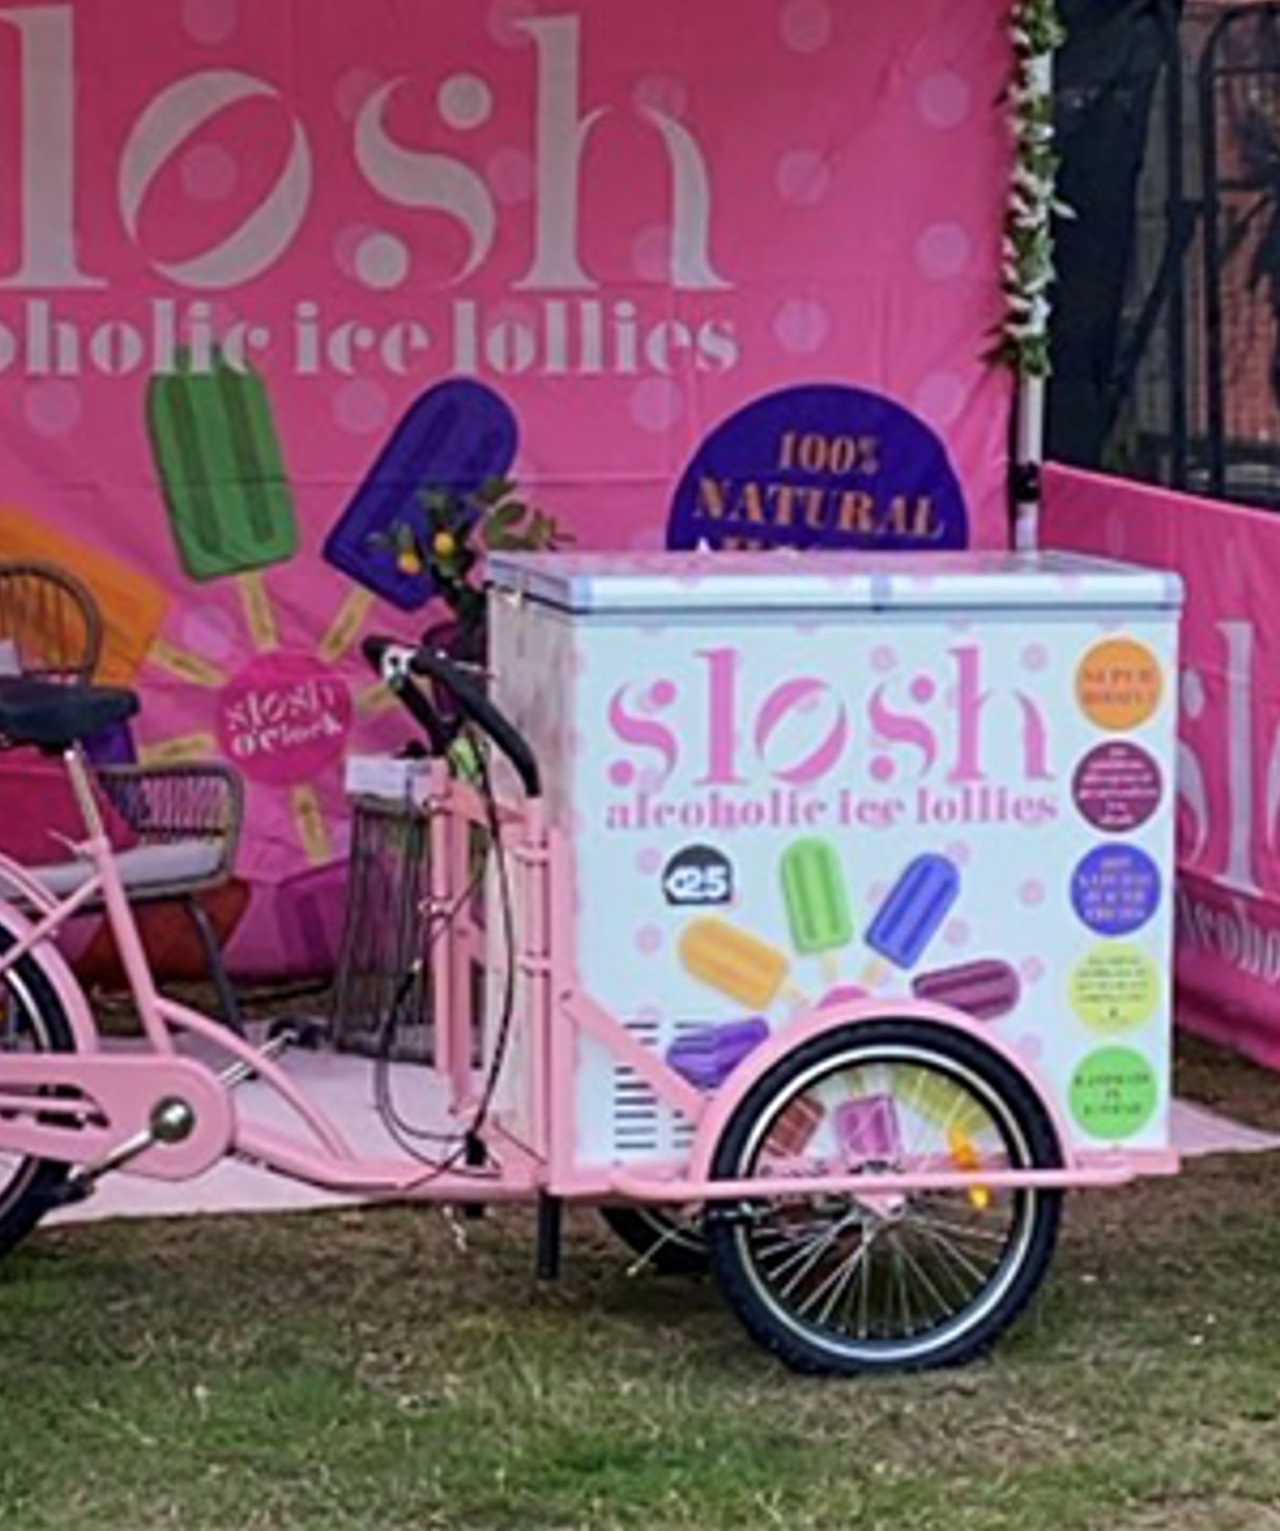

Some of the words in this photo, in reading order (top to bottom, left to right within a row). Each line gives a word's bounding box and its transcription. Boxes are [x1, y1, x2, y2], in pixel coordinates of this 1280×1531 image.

[294, 299, 429, 376] ice
[453, 298, 740, 378] lollies
[778, 428, 883, 475] 100%
[693, 476, 946, 540] NATURAL
[608, 645, 1057, 788] slosh
[605, 789, 827, 830] alcoholic
[837, 788, 905, 828] ice
[917, 784, 1060, 824] lollies
